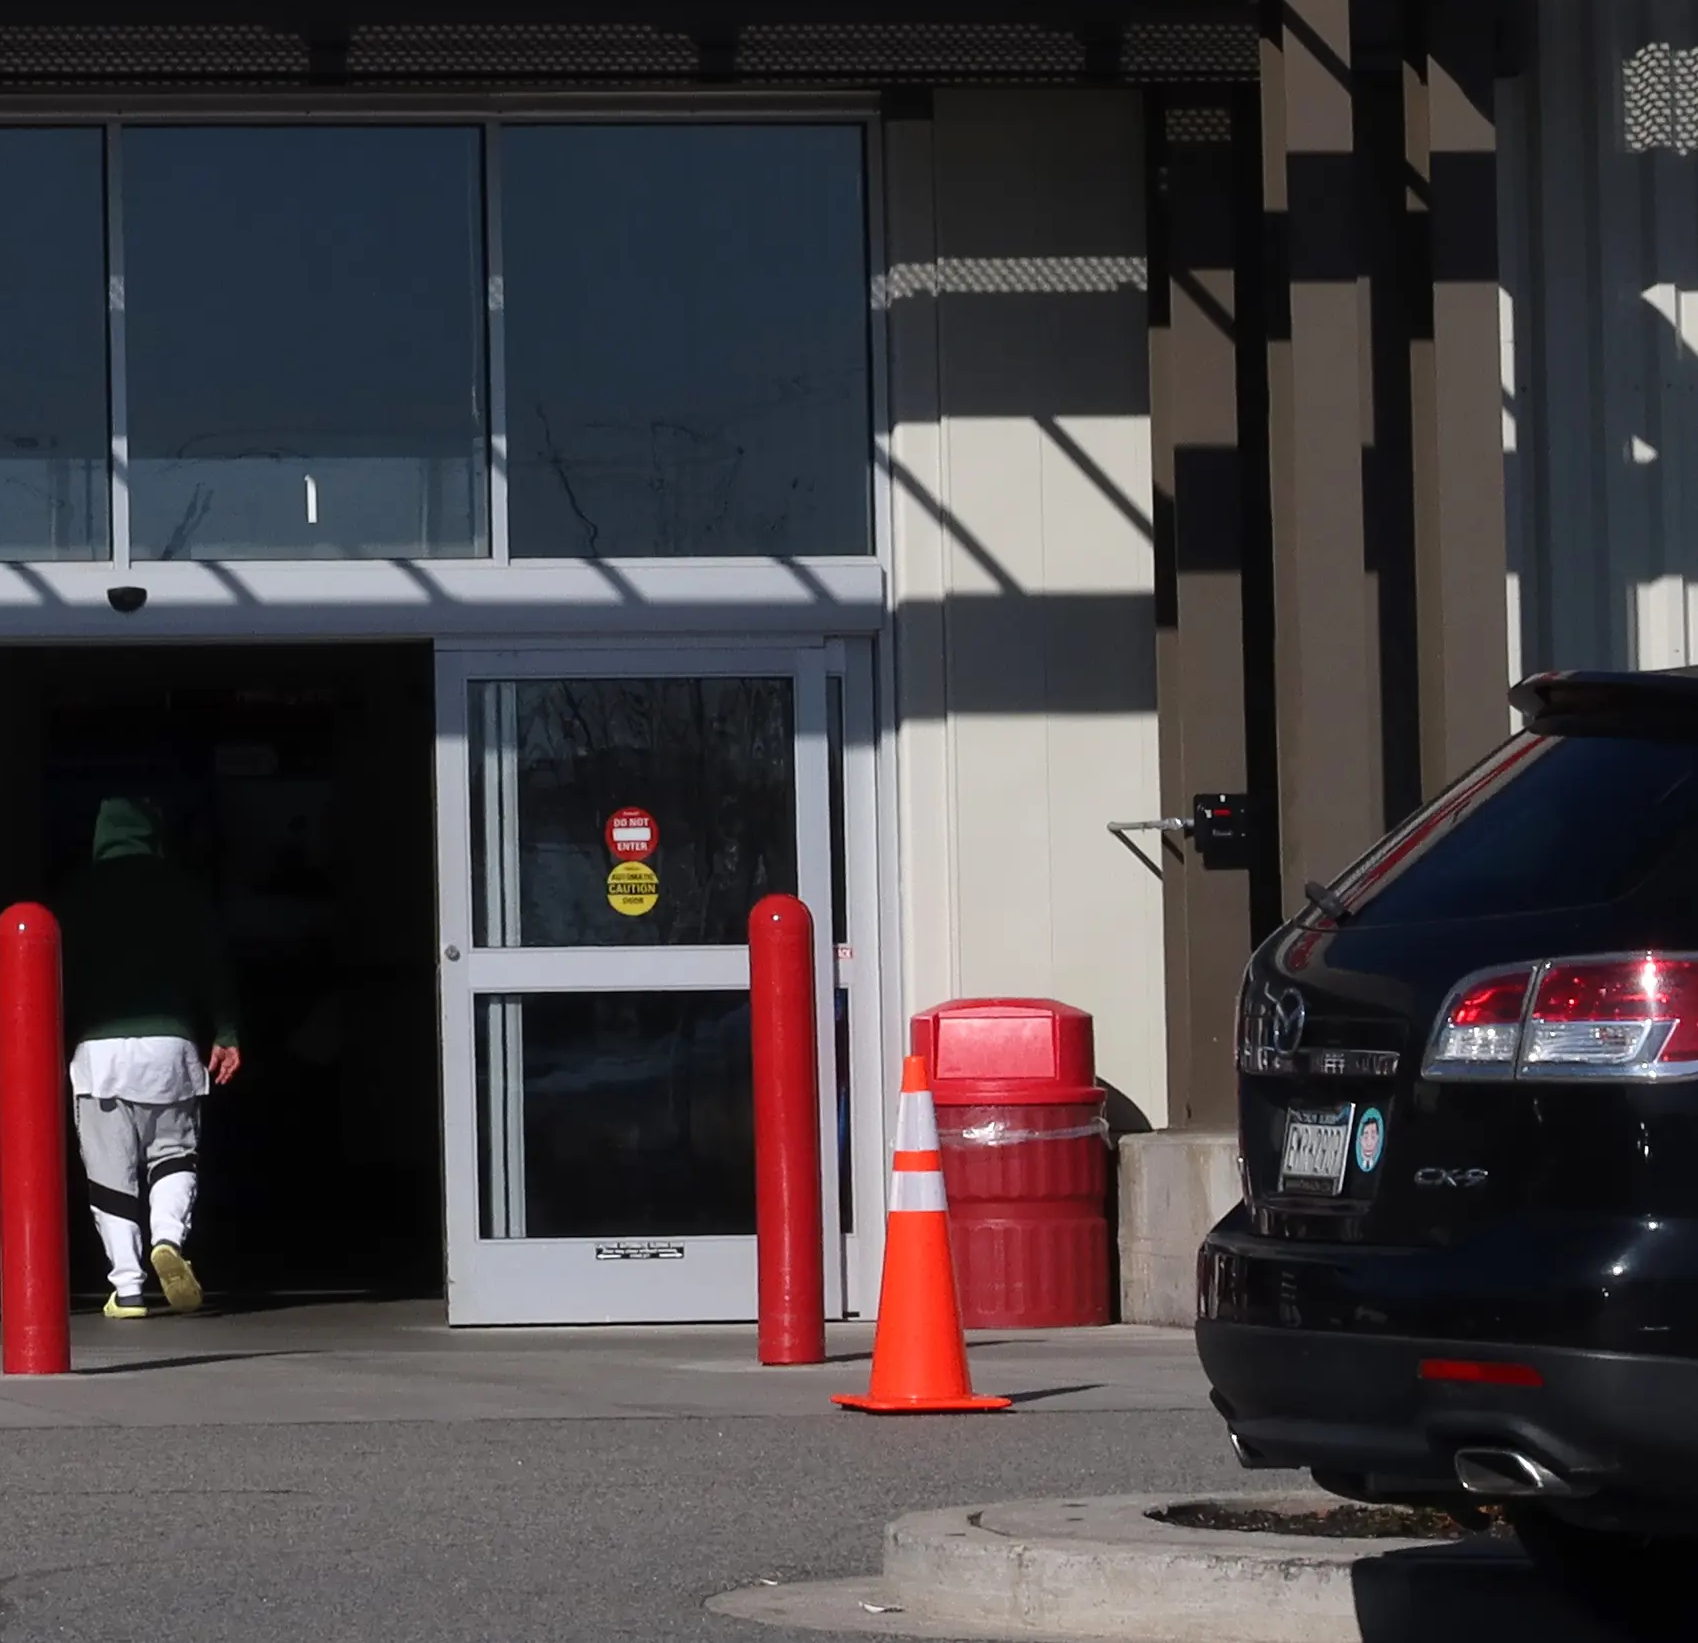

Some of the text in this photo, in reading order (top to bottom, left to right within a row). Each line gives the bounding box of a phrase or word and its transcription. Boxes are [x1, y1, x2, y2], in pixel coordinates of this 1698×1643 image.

[304, 474, 317, 523] 1
[613, 818, 649, 827] DO NOT
[617, 842, 648, 851] ENTER
[609, 884, 656, 894] CAUTION
